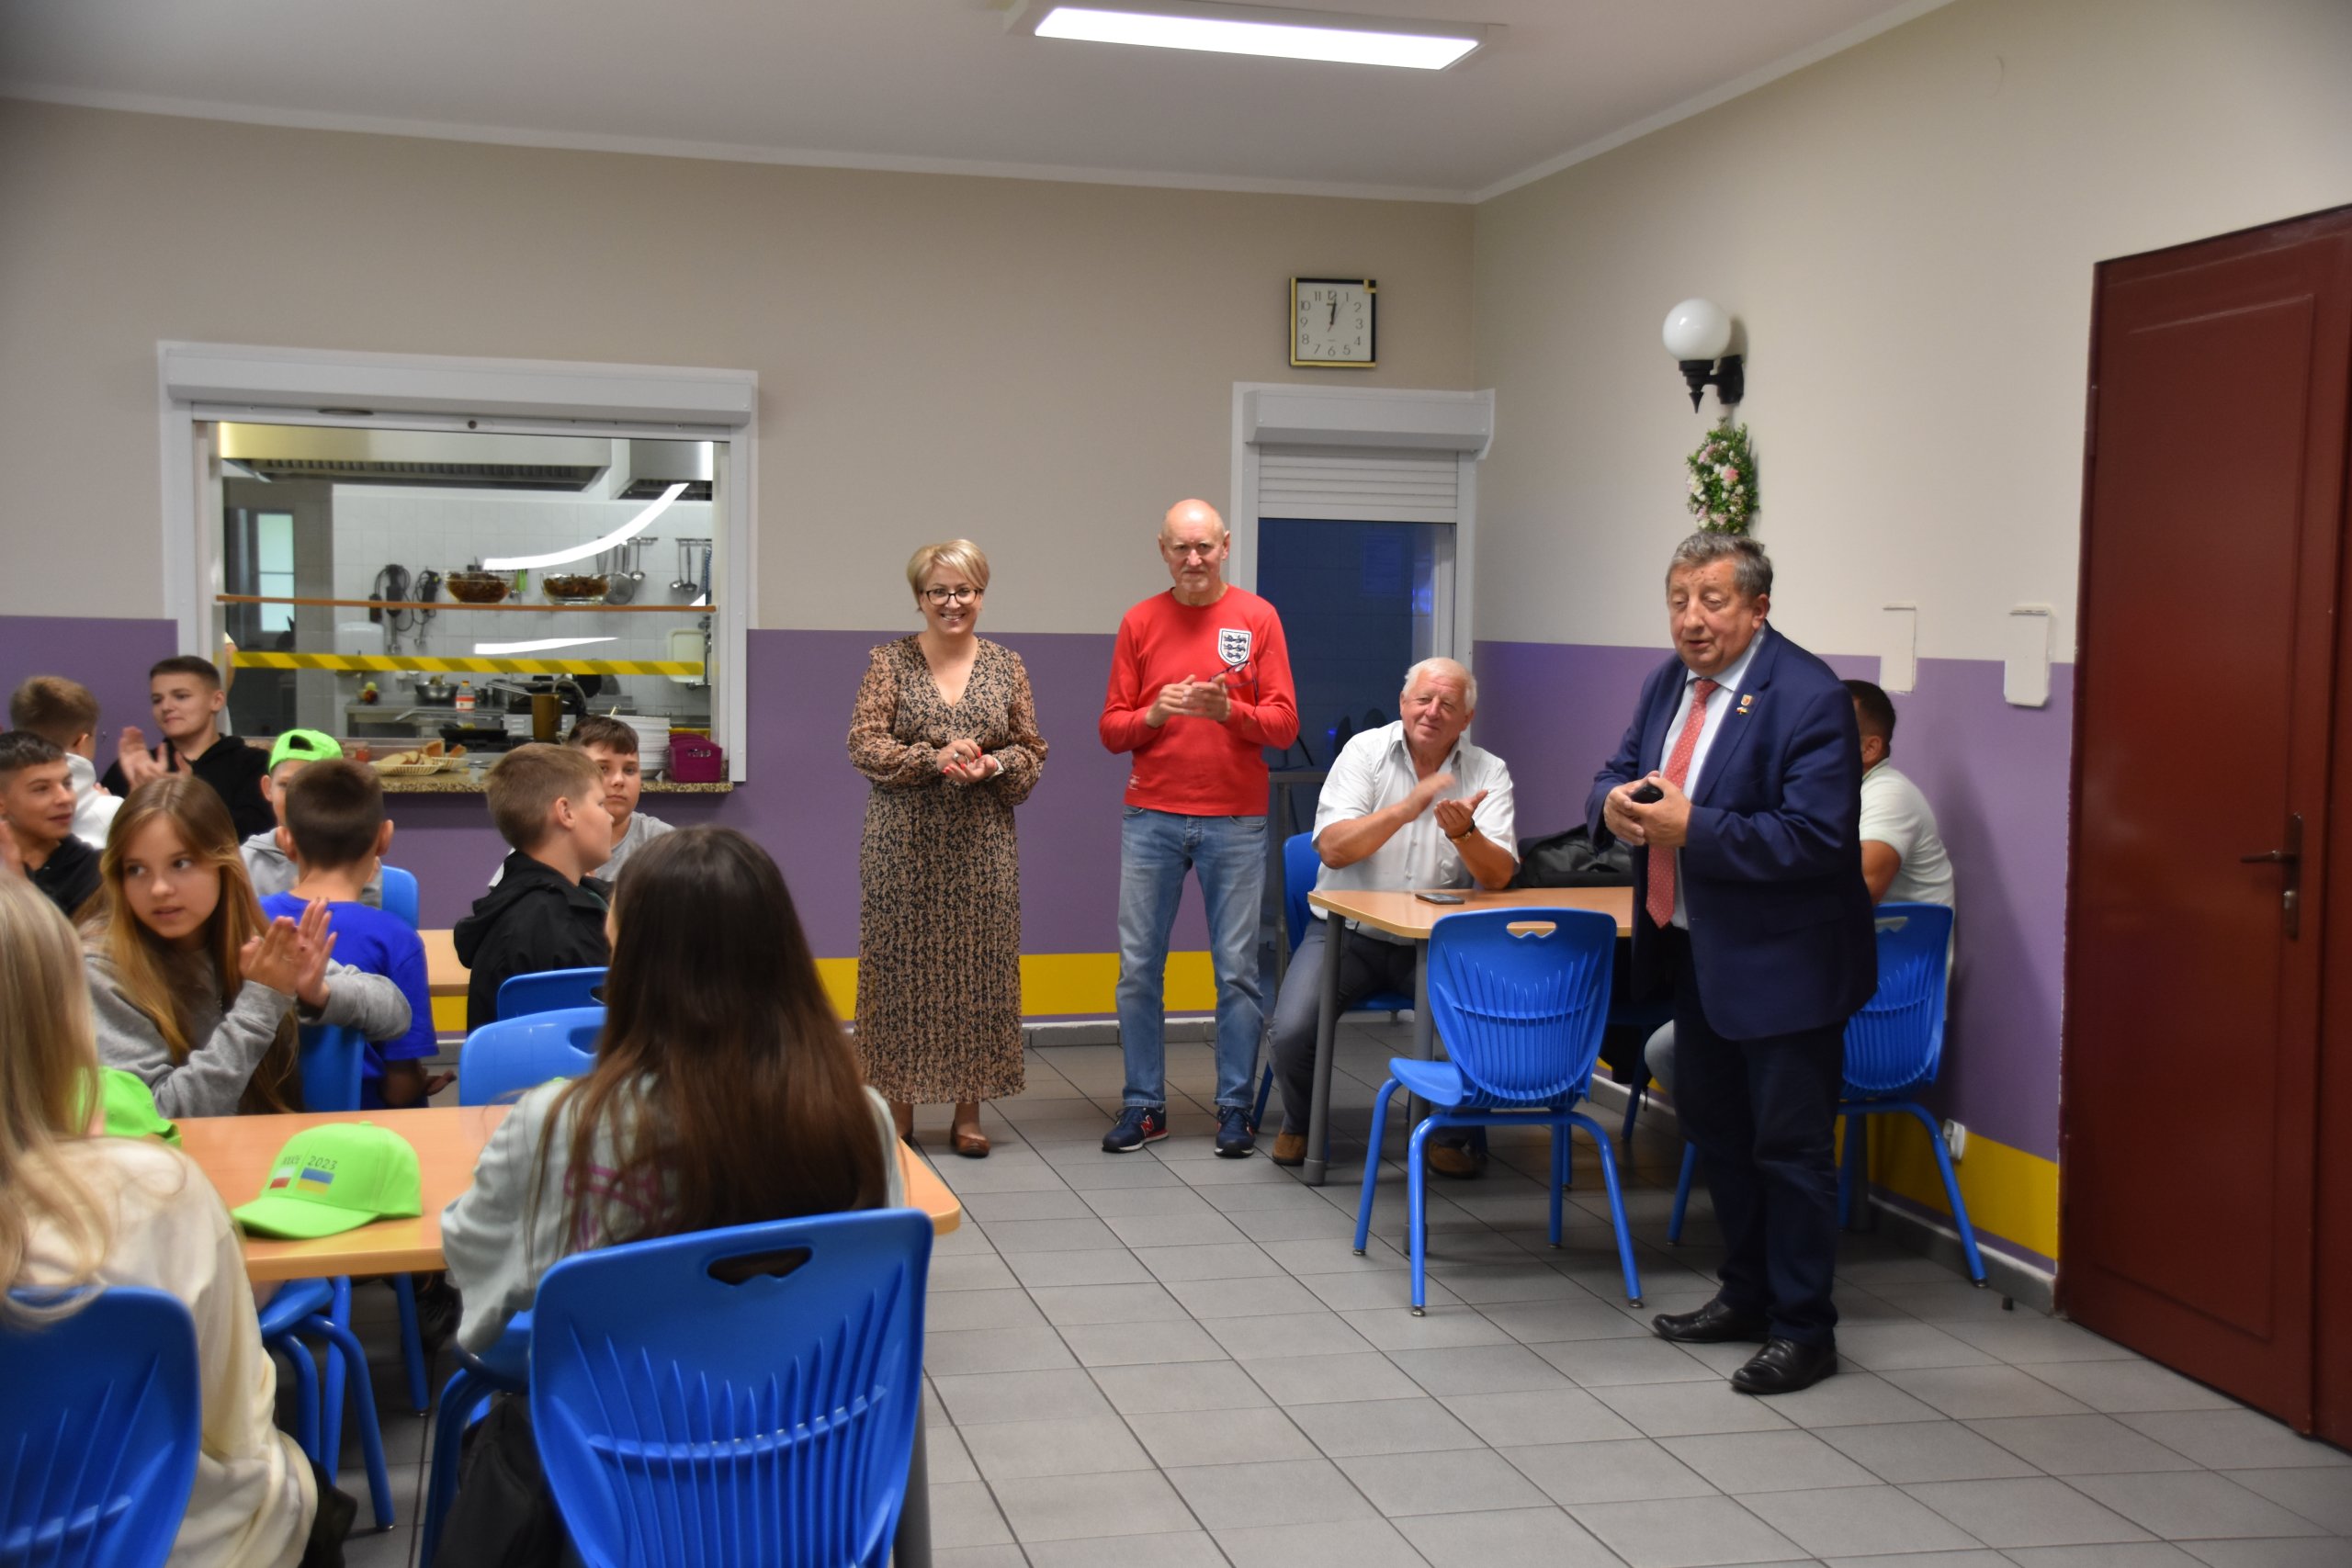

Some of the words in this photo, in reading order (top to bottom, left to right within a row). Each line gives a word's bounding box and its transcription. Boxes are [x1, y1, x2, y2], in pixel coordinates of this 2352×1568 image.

[1314, 290, 1321, 301] 11
[1300, 300, 1311, 311] 10
[1353, 301, 1362, 312] 2
[1300, 317, 1308, 328] 9
[1355, 318, 1363, 330] 3
[1301, 333, 1310, 344] 8
[1353, 336, 1361, 345] 4
[1314, 344, 1321, 355] 7
[1328, 345, 1336, 356] 6
[1342, 344, 1351, 355] 5
[308, 1155, 338, 1170] 2023
